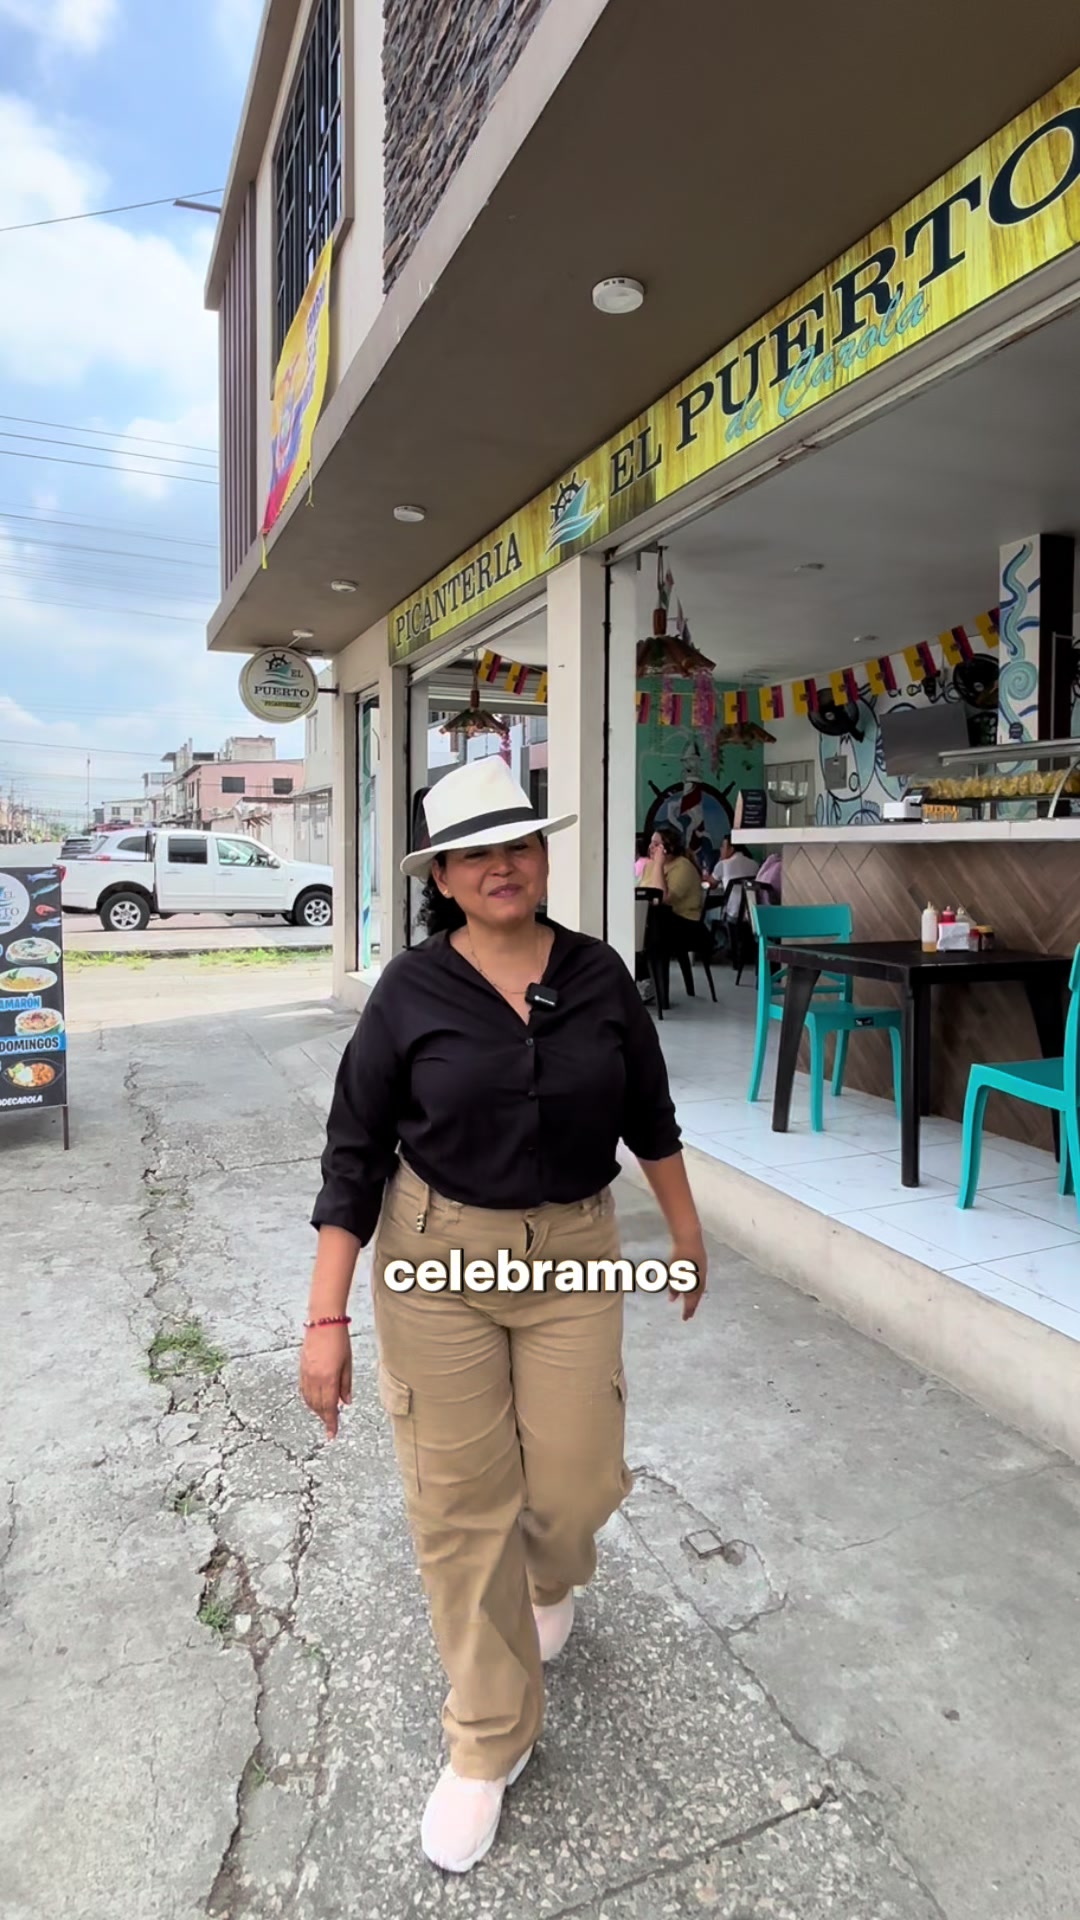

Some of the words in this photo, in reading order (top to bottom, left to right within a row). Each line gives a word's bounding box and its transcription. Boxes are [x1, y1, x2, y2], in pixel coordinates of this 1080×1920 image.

[725, 393, 762, 443] de
[778, 287, 926, 418] Carola
[395, 532, 522, 647] PICANTERIA
[610, 427, 662, 497] EL
[676, 106, 1080, 451] PUERTO
[291, 669, 304, 678] EL
[254, 686, 310, 697] PUERTO
[0, 1036, 59, 1053] DOMINGOS
